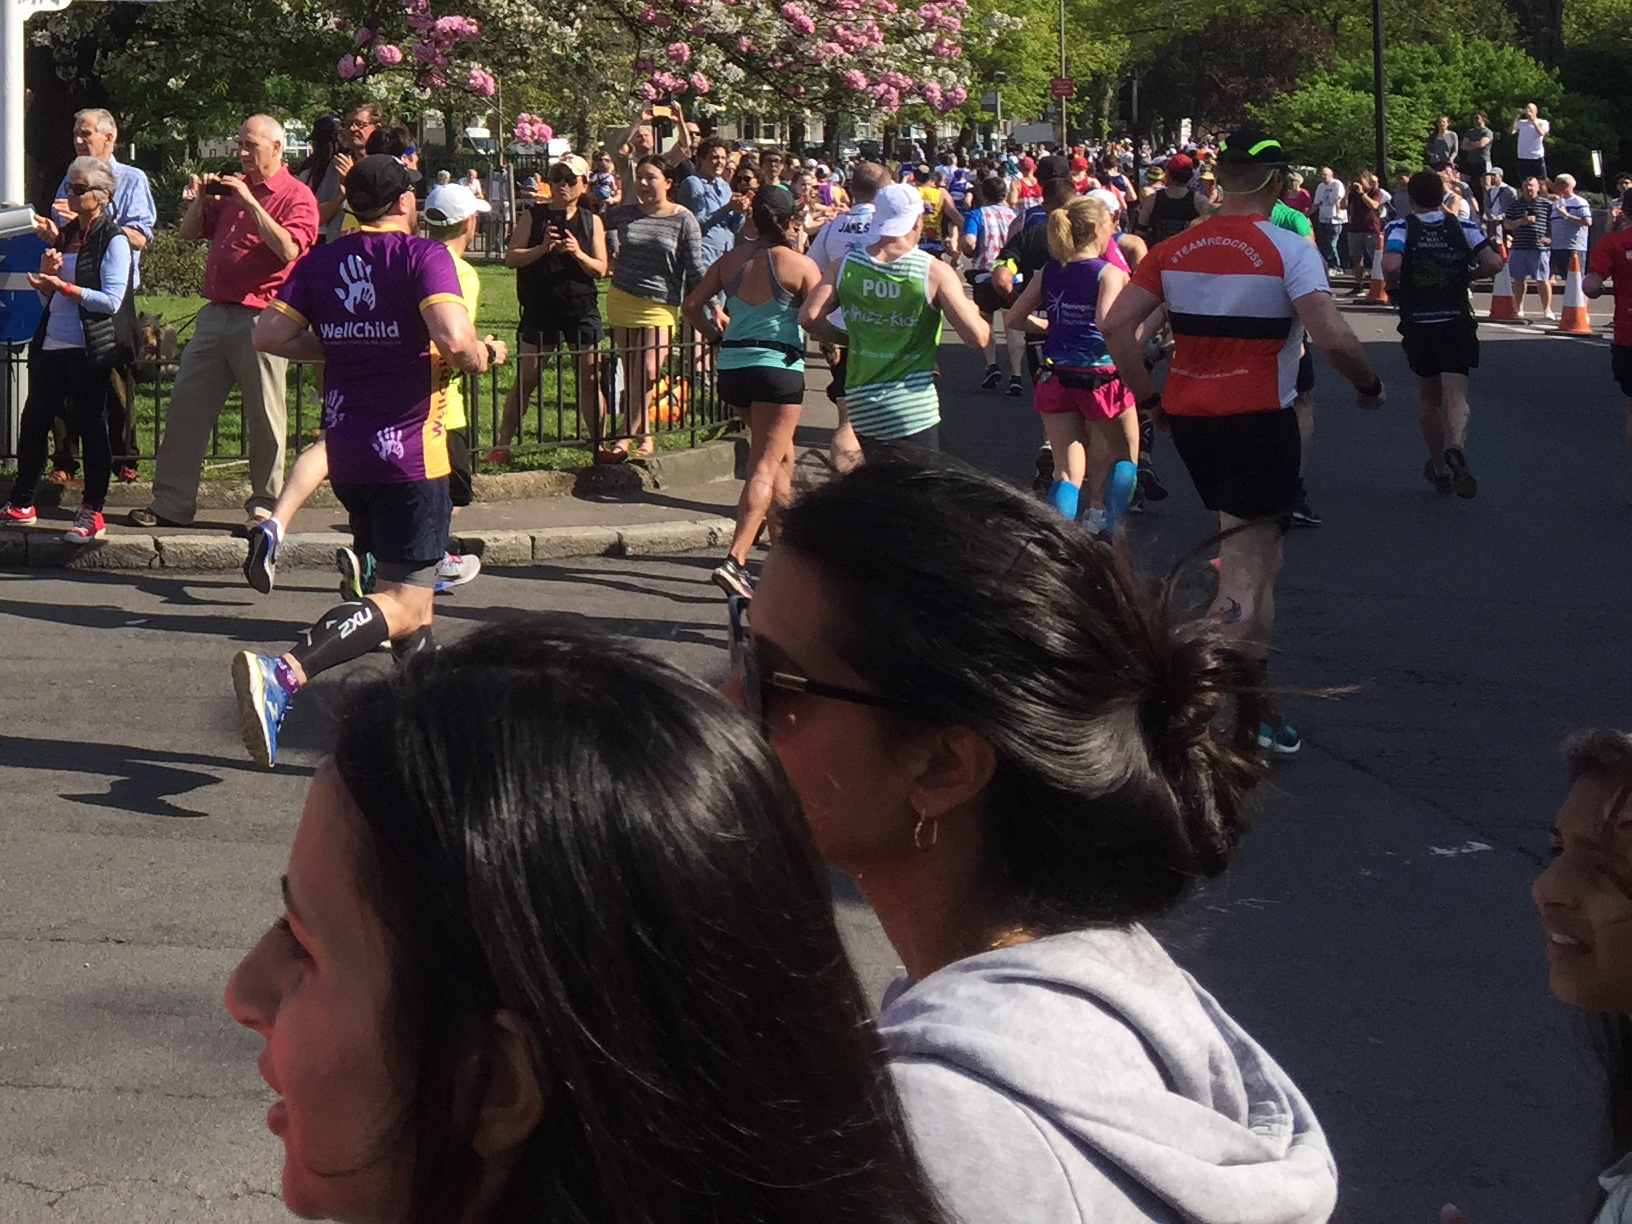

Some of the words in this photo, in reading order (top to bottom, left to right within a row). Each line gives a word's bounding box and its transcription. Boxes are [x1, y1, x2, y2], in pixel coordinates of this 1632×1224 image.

[862, 279, 901, 299] POD
[319, 320, 400, 339] WellChild
[337, 607, 373, 640] 2XU
